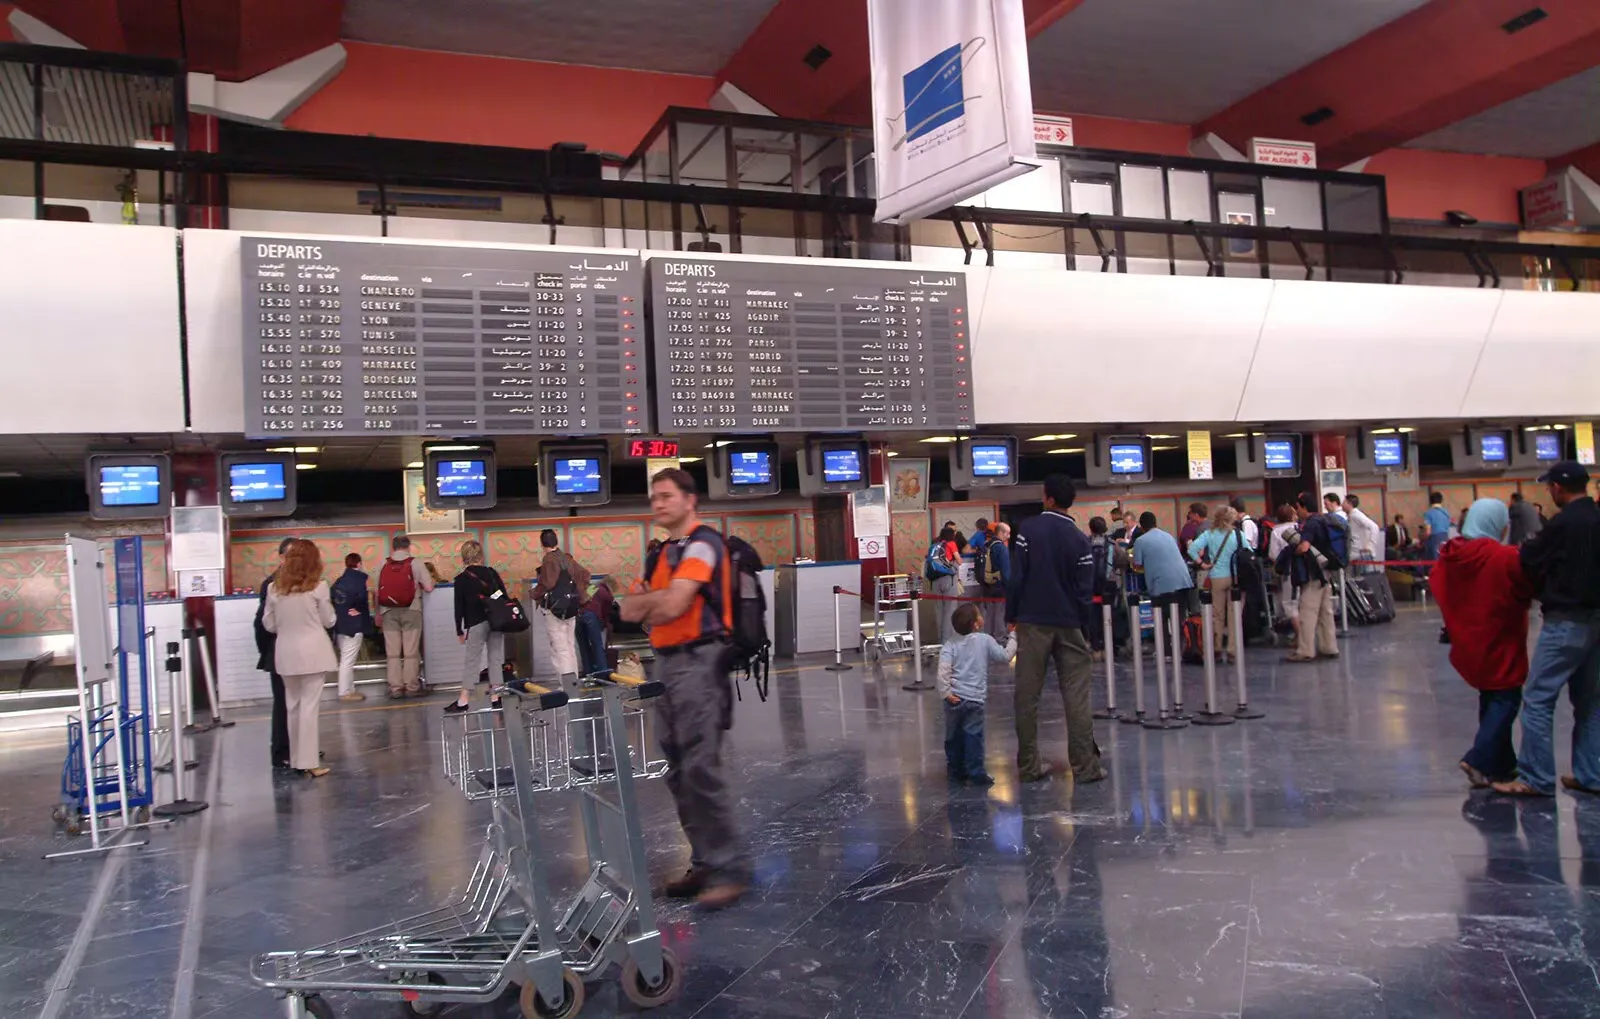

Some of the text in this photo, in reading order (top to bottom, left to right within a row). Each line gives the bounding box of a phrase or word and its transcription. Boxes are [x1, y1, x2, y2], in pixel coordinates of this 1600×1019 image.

[1034, 133, 1051, 141] ERIE
[257, 244, 322, 260] DEPARTS
[665, 263, 716, 277] DEPARTS
[260, 283, 290, 292] 15.10
[320, 285, 339, 293] 534
[361, 286, 414, 296] CHARLERO
[537, 292, 563, 301] 30-33
[261, 298, 291, 307] 15.20
[319, 299, 340, 308] 930
[361, 301, 400, 310] GENEVE
[668, 297, 692, 305] 17.00
[261, 313, 291, 322] 15.40
[320, 315, 340, 323] 720
[362, 316, 388, 324] LYON
[669, 324, 693, 332] 17.05
[262, 329, 292, 337] 15.55
[321, 330, 340, 338] 570
[363, 330, 395, 339] TUNIS
[262, 344, 292, 352] 16.10
[321, 345, 341, 353] 730
[362, 346, 415, 354] MARSEILL
[262, 360, 292, 368] 16.10
[321, 360, 342, 368] 409
[363, 361, 416, 369] MARRAKEC
[263, 375, 292, 383] 16.35
[322, 375, 341, 383] 792
[363, 375, 416, 384] BORDEAUX
[263, 390, 293, 398] 16.35
[322, 390, 342, 398] 962
[364, 390, 417, 398] BARCELON
[263, 405, 294, 414] 16.40
[323, 405, 342, 413] 422
[364, 405, 397, 413] PARIS
[264, 420, 294, 429] 16.50
[323, 420, 343, 428] 256
[365, 420, 391, 428] RIAD
[631, 440, 678, 456] 15 30 27
